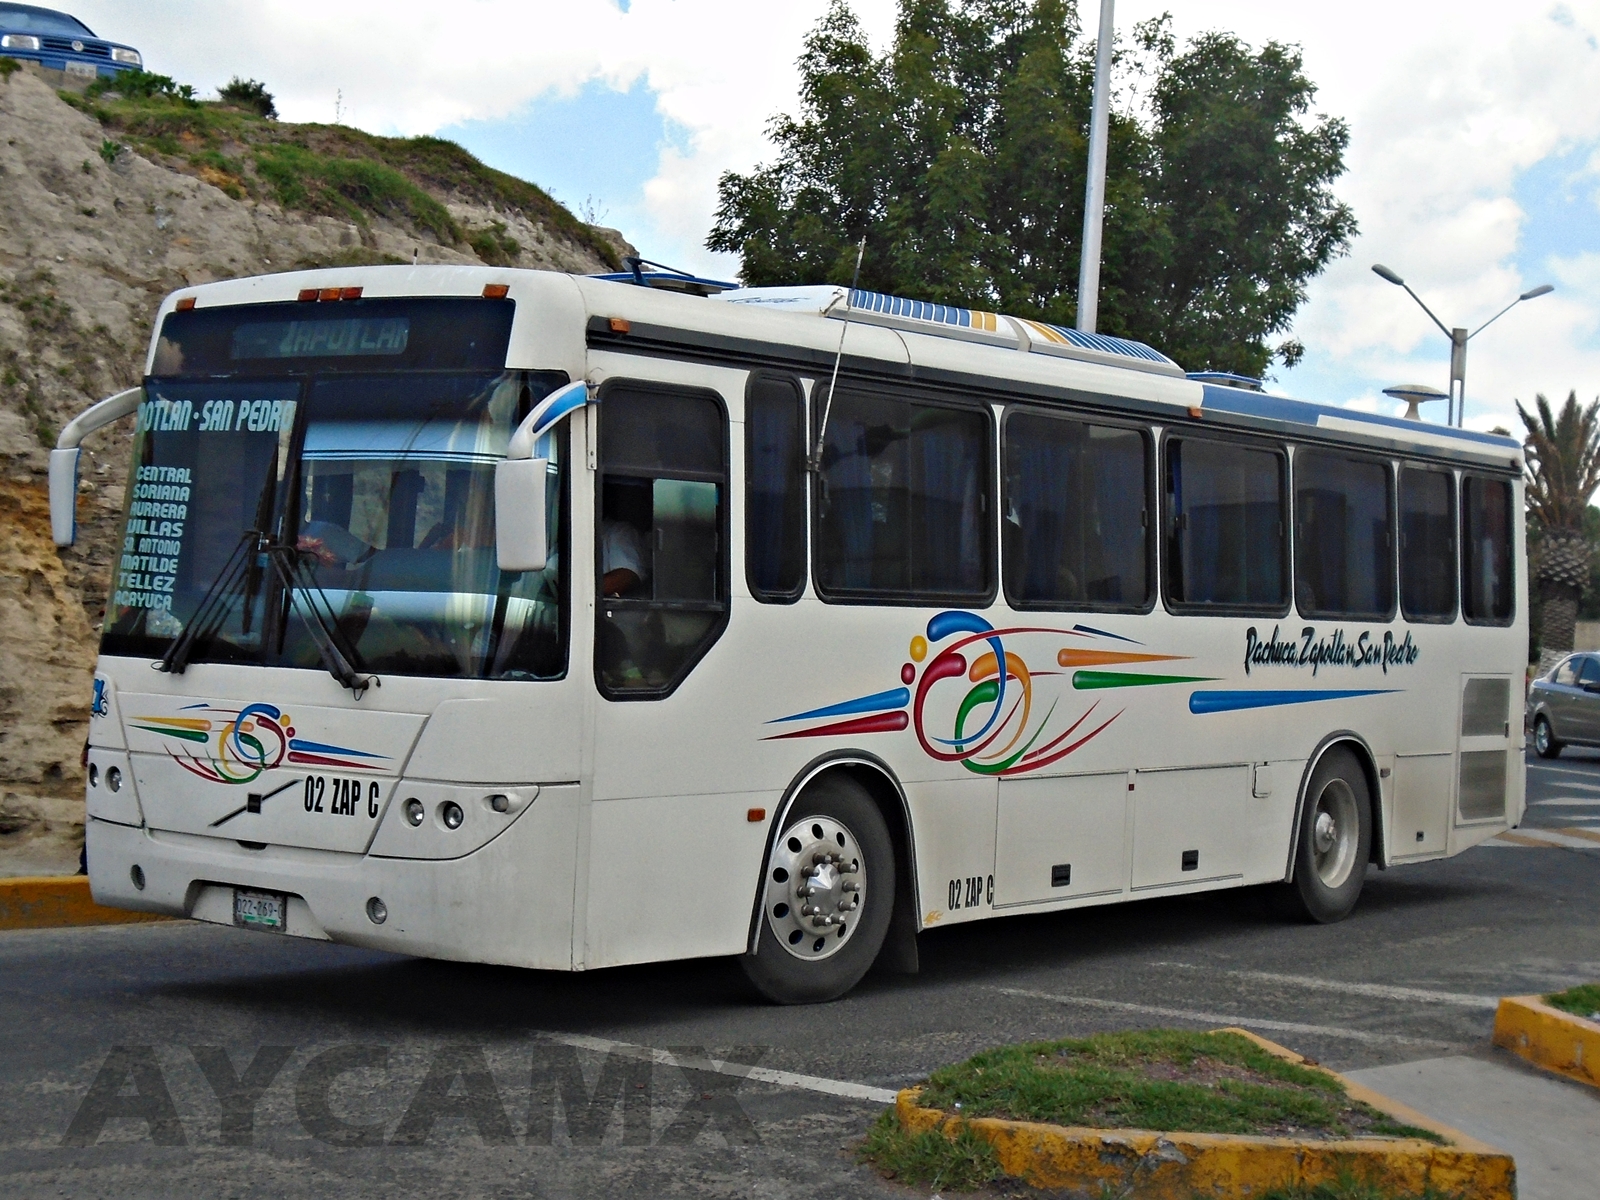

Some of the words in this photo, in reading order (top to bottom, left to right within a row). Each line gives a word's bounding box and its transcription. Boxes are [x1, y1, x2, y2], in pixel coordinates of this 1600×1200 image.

[199, 400, 234, 432] SAN
[235, 400, 295, 432] PEDRO
[136, 465, 192, 484] CENTRAL
[133, 483, 190, 502] SORIANA
[130, 501, 187, 520] AURRERA
[138, 537, 181, 556] ANTONIO
[120, 554, 179, 574] MATILDE
[119, 572, 175, 592] TELLEZ
[114, 590, 172, 611] ACAYUCA
[1353, 630, 1382, 668] San
[1381, 630, 1421, 676] Pedro
[304, 775, 325, 813] 02
[331, 778, 361, 817] ZAP
[368, 781, 379, 819] C
[948, 879, 962, 911] 02
[965, 876, 983, 908] ZAP
[986, 873, 994, 905] C
